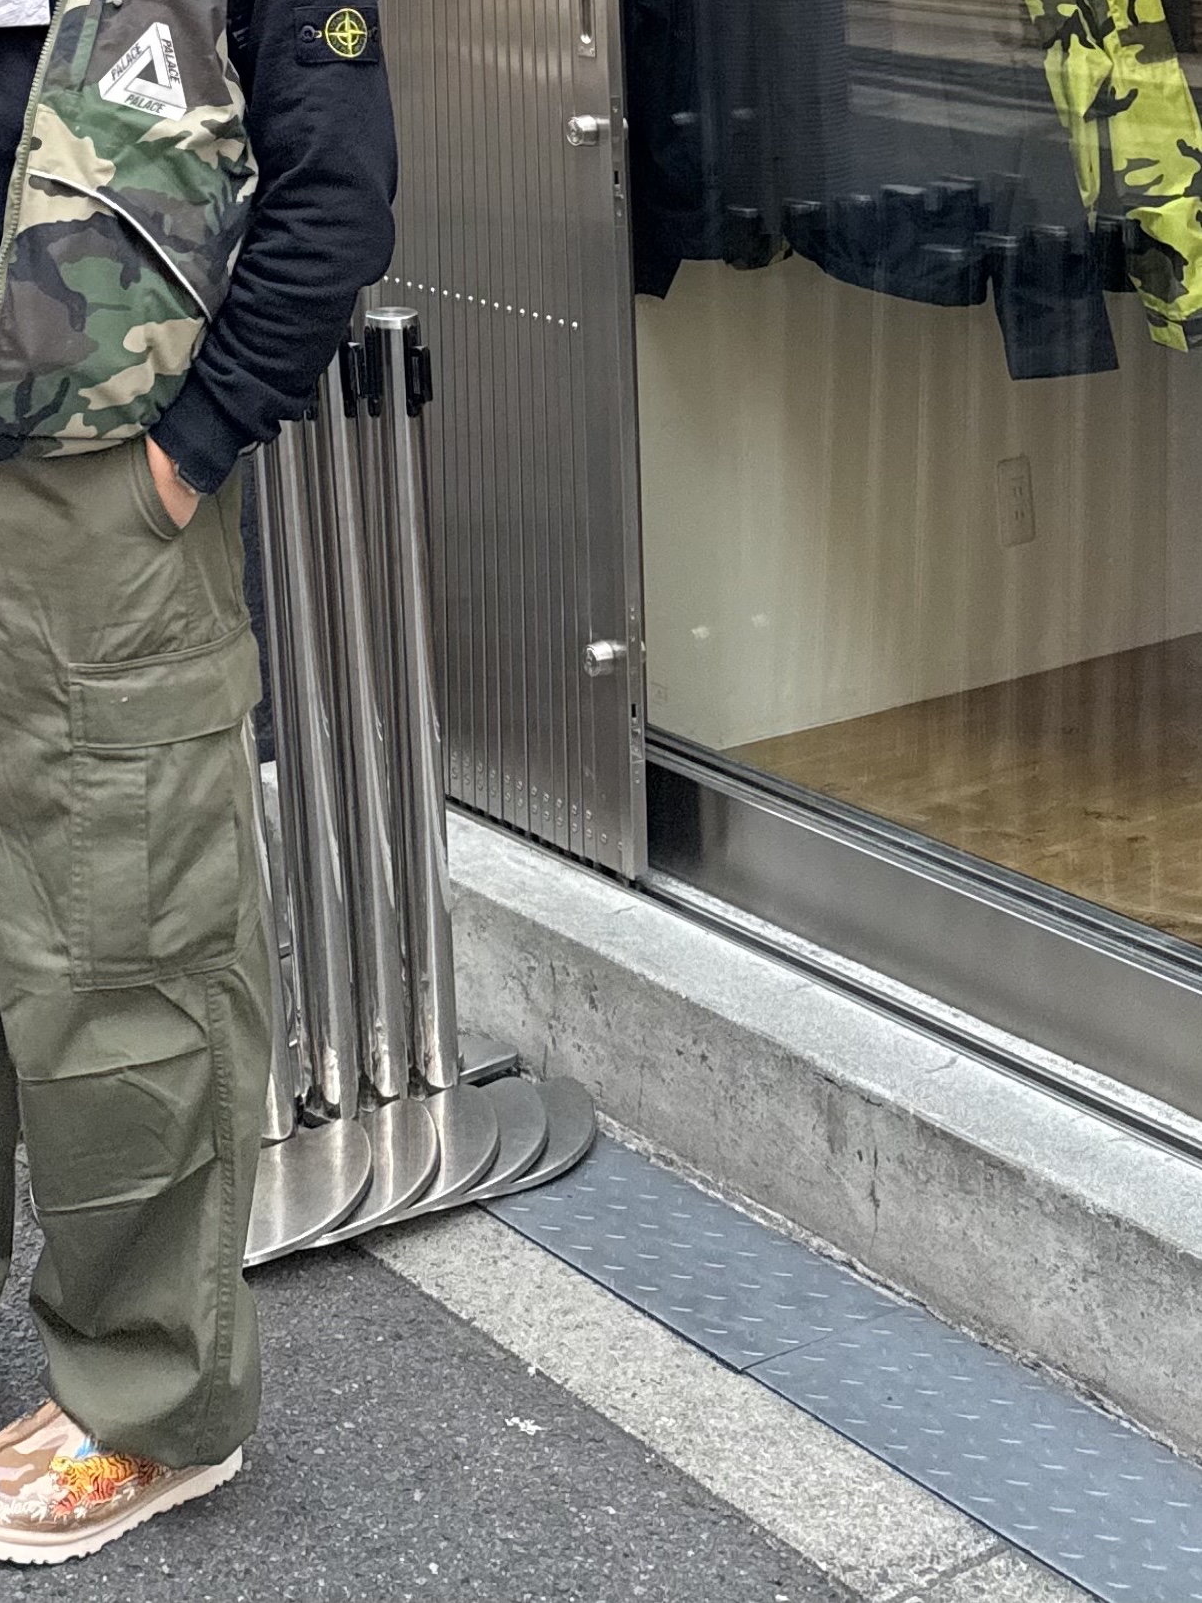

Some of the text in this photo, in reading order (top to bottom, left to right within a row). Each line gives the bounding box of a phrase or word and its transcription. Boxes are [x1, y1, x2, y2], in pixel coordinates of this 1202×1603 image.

[110, 40, 144, 82] PALACE
[161, 37, 181, 85] PALACE
[123, 93, 167, 115] PALACE
